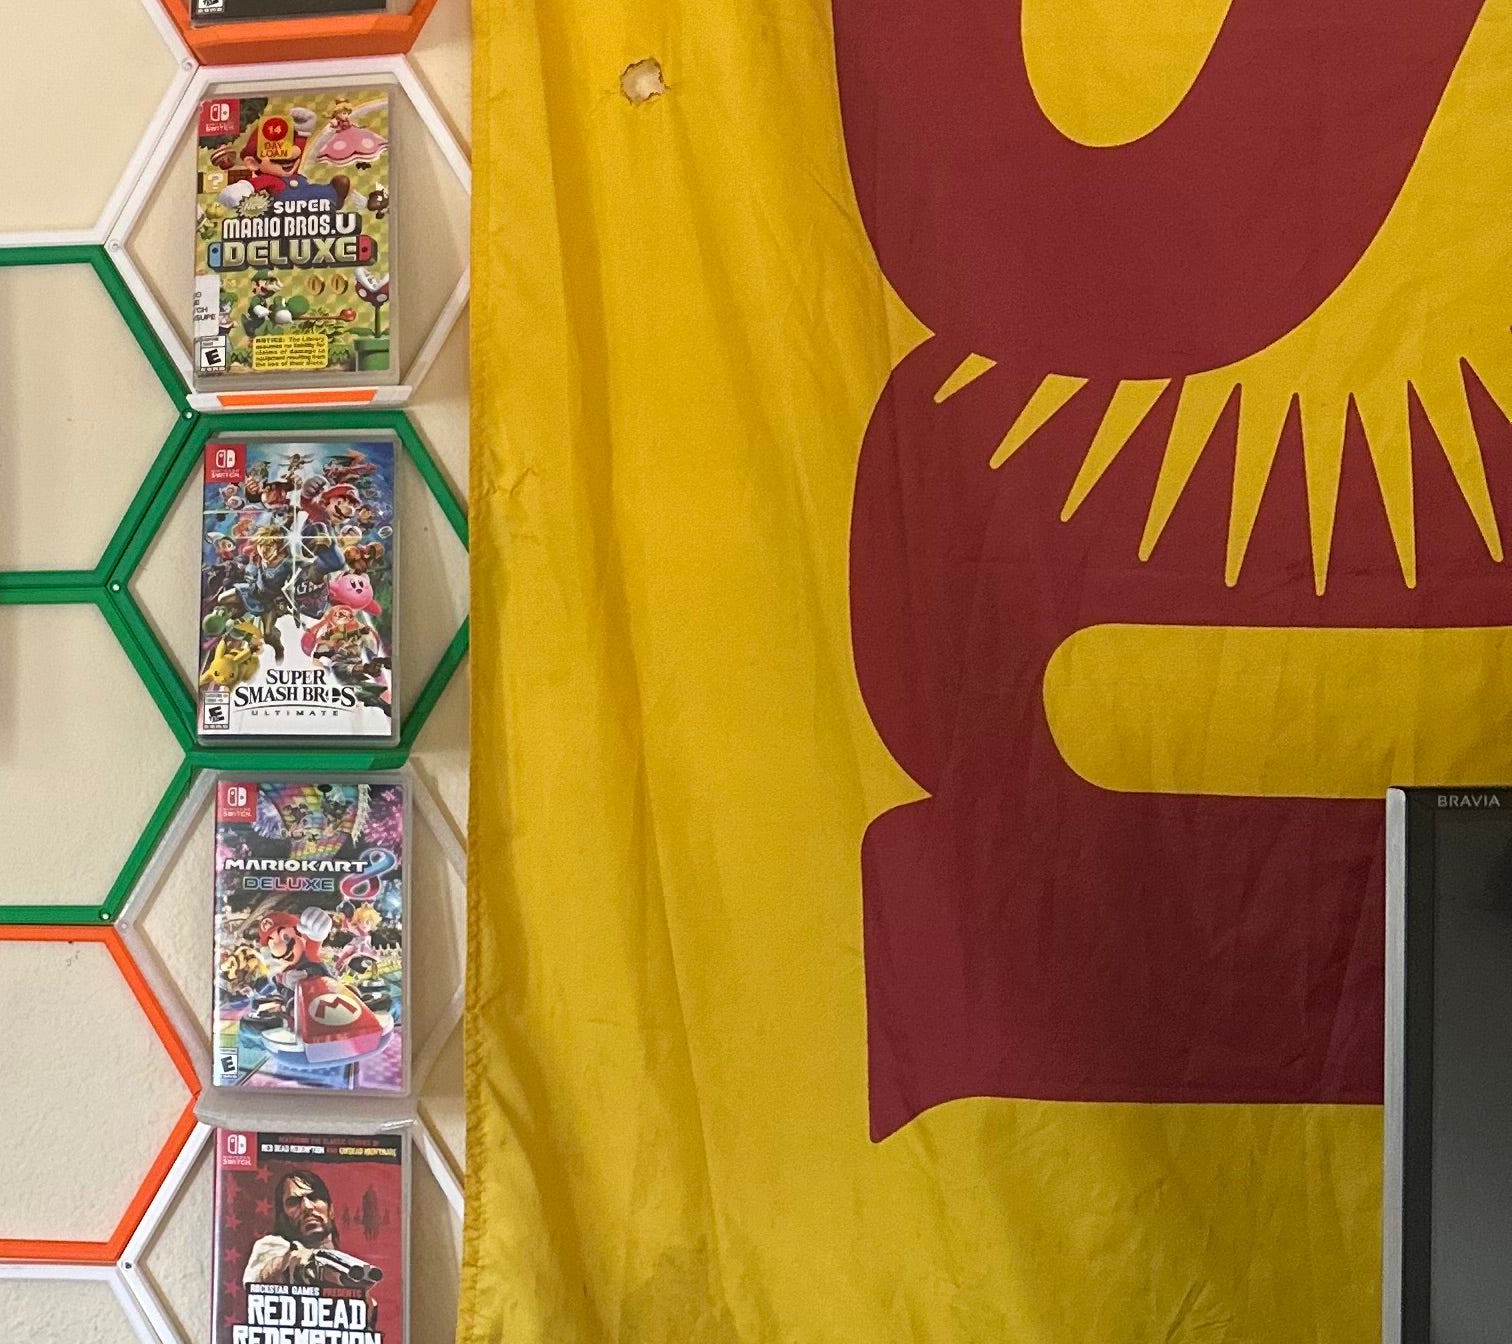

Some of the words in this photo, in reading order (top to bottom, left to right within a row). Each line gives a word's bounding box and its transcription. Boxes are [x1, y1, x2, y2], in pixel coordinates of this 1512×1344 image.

[269, 125, 281, 134] 14
[274, 199, 330, 214] SUPER
[223, 217, 281, 239] MARIO
[223, 236, 357, 267] DELUXE
[266, 669, 326, 685] SUPER
[234, 686, 298, 707] SMASH
[303, 686, 356, 707] BROS
[1437, 794, 1501, 807] BRAVIA
[340, 848, 397, 900] 8
[243, 876, 334, 892] DELUXE
[250, 1284, 288, 1295] ROCKSTAR
[292, 1286, 320, 1296] GAMES
[248, 1294, 296, 1326] RED
[301, 1297, 367, 1330] DEAD
